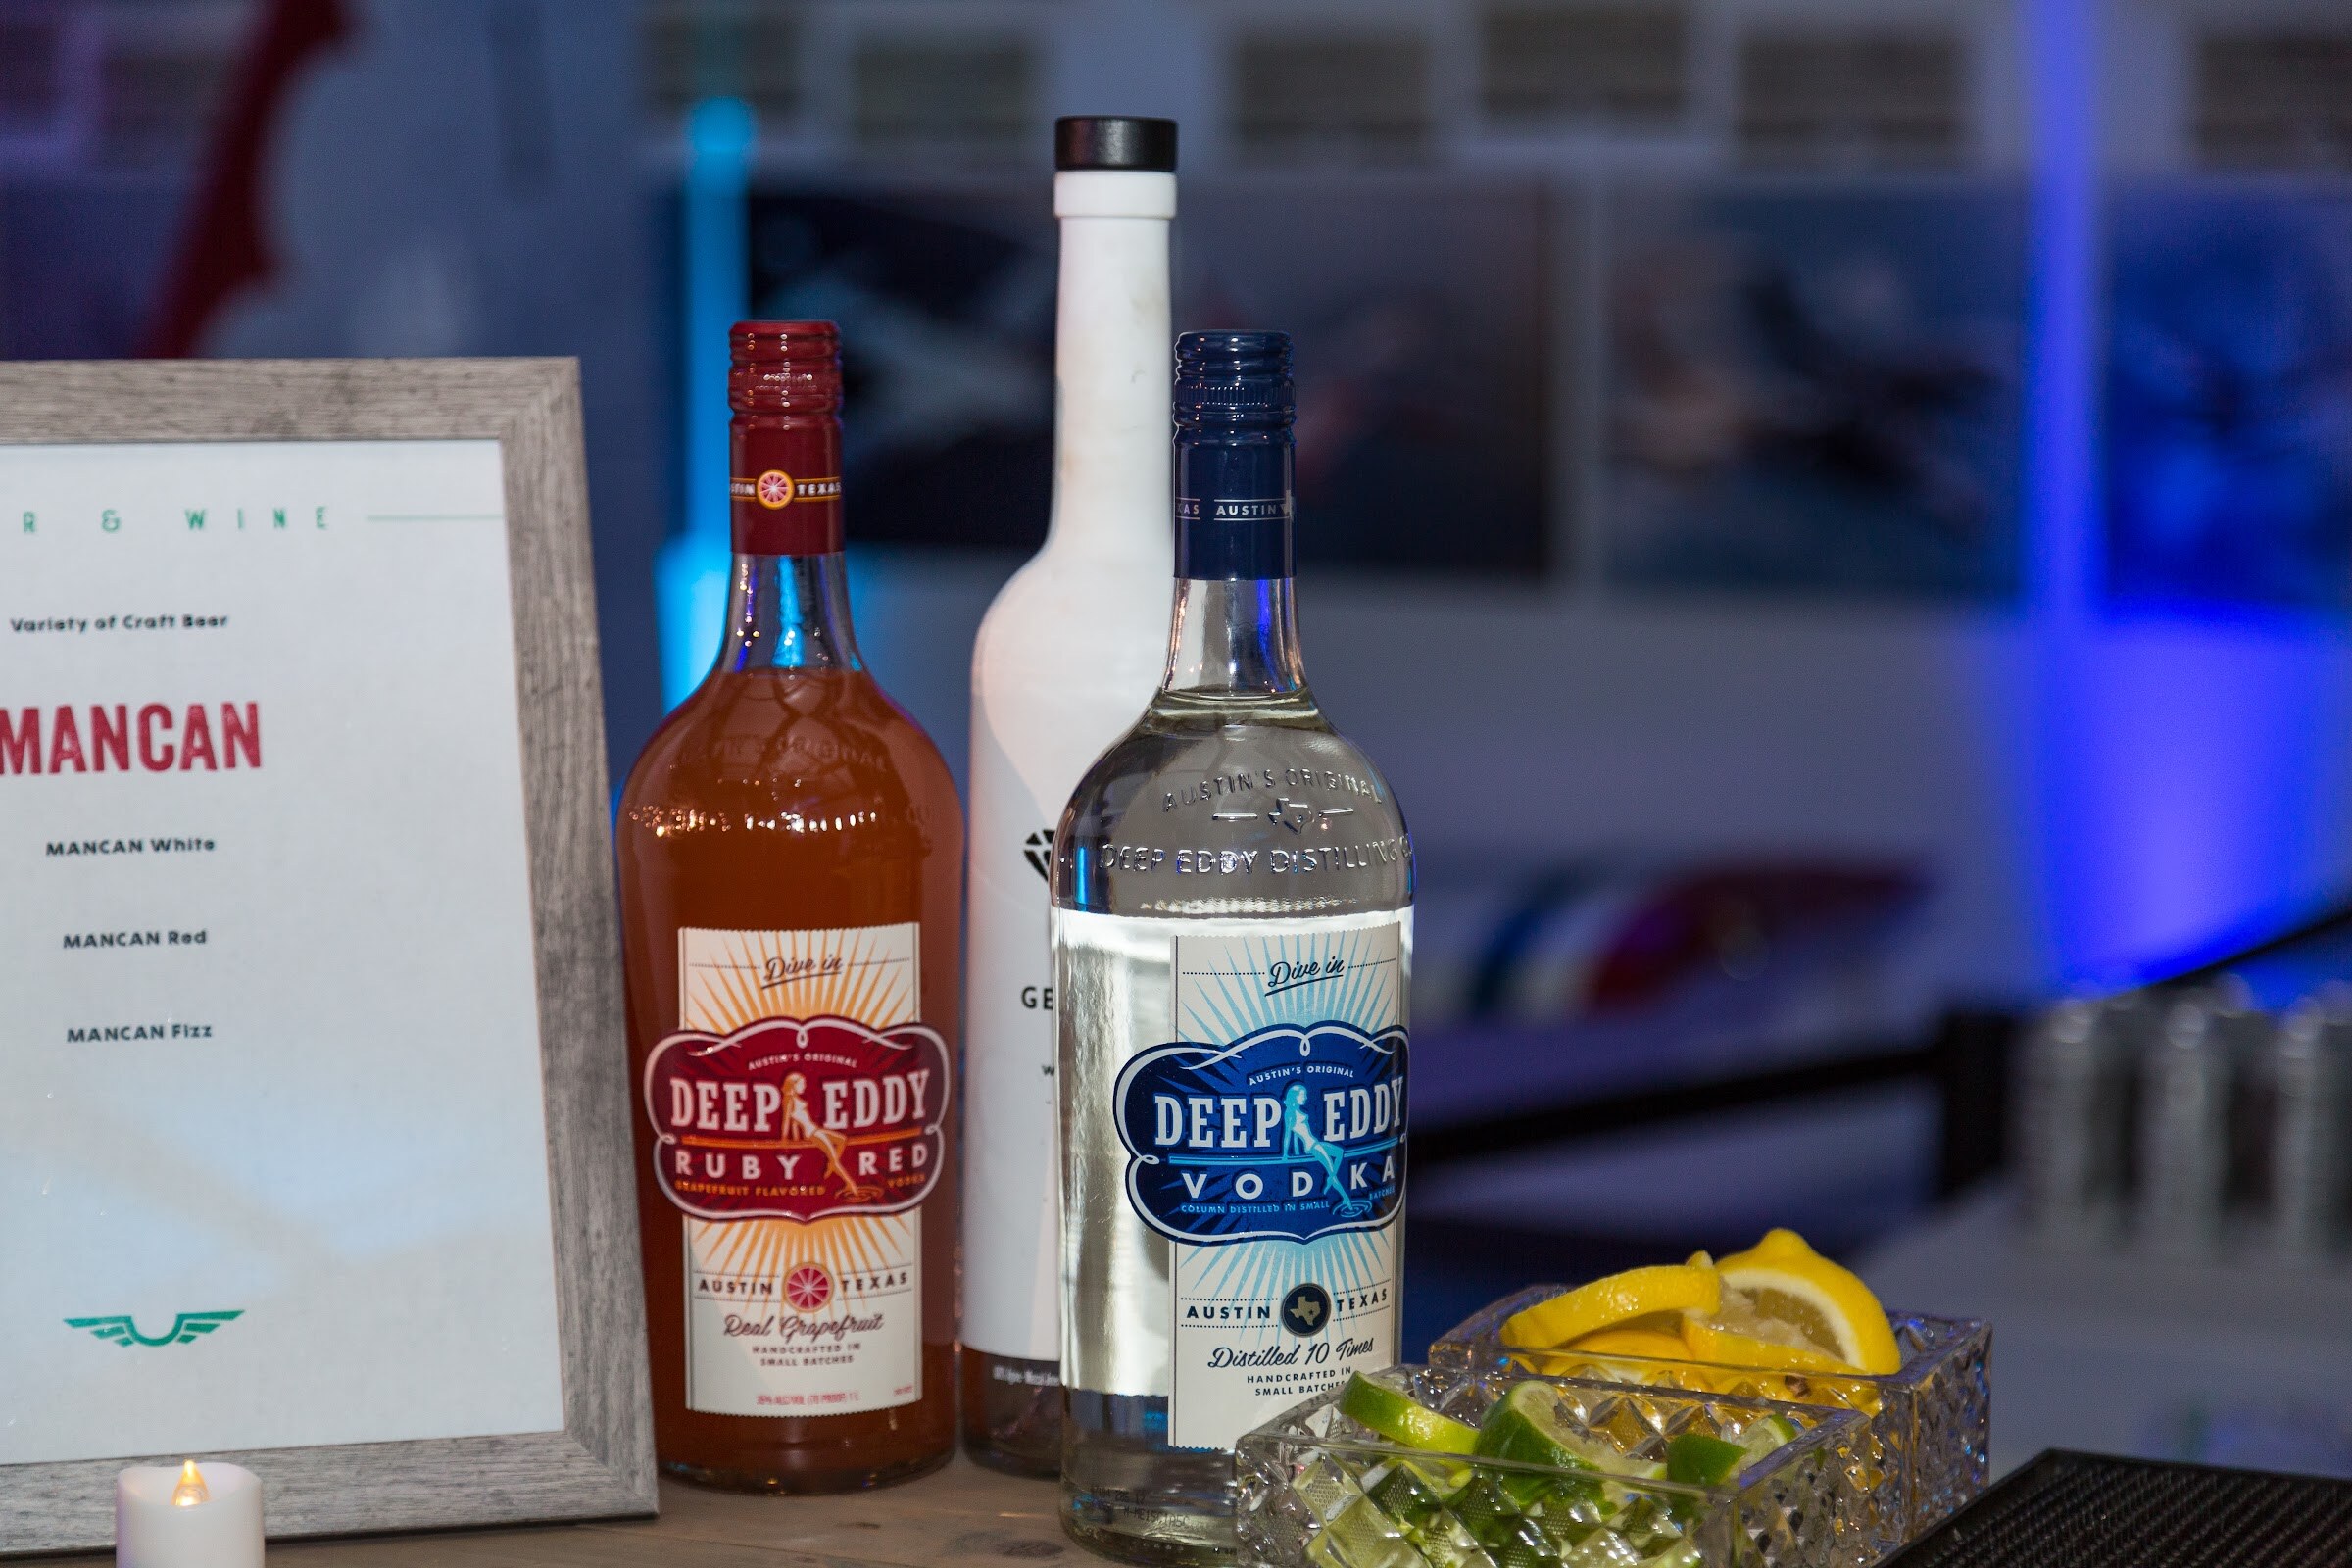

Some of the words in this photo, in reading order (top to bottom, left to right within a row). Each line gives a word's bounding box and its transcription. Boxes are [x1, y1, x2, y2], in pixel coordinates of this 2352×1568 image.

[797, 481, 842, 497] TEXAS
[100, 508, 122, 534] &
[184, 505, 328, 532] WINE
[1215, 505, 1277, 516] AUSTIN
[10, 617, 87, 634] Variety
[95, 614, 117, 630] of
[122, 614, 175, 630] Craft
[182, 614, 228, 628] Beer
[0, 701, 262, 775] MANCAN
[1162, 768, 1277, 812] AUSTIN'S
[1284, 768, 1382, 804] ORIGINAL
[46, 839, 144, 856] MANCAN
[150, 836, 217, 853] White
[1099, 844, 1167, 873] DEEP
[1176, 848, 1259, 876] EDDY
[63, 931, 161, 949] MANCAN
[168, 928, 208, 945] Red
[763, 956, 816, 980] Dive
[821, 954, 844, 972] in
[1268, 960, 1321, 988] Dive
[1324, 956, 1345, 975] in
[67, 1024, 165, 1043] MANCAN
[172, 1022, 213, 1039] Fizz
[748, 1054, 800, 1071] AUSTIN'S
[803, 1053, 858, 1069] ORIGINAL
[1249, 1065, 1302, 1087] AUSTIN'S
[1306, 1064, 1354, 1079] ORIGINAL
[669, 1077, 782, 1133] DEEP
[821, 1069, 931, 1130] EDDY
[1154, 1094, 1283, 1149] DEEP
[1323, 1076, 1404, 1143] EDDY
[674, 1150, 803, 1181] RUBY
[858, 1142, 929, 1177] RED
[1181, 1155, 1396, 1200] VODKA
[755, 1186, 826, 1197] FLAVORED
[1181, 1203, 1225, 1215] COLUMN
[1229, 1203, 1281, 1215] DISTILLED
[1284, 1202, 1297, 1213] IN
[1299, 1200, 1331, 1212] SMALL
[698, 1278, 773, 1296] AUSTIN
[841, 1272, 908, 1293] TEXAS
[1186, 1305, 1271, 1320] AUSTIN
[1336, 1287, 1389, 1313] TEXAS
[723, 1314, 775, 1338] Real
[778, 1313, 885, 1344] Grapefruit
[752, 1343, 842, 1355] HANDCRAFTED
[847, 1342, 861, 1351] IN
[1207, 1345, 1299, 1368] Distilled
[1303, 1341, 1330, 1365] 10
[1335, 1337, 1375, 1361] Times
[760, 1357, 798, 1367] SMALL
[802, 1354, 856, 1367] BATCHES
[1247, 1369, 1337, 1384] HANDCRAFTED
[1341, 1366, 1352, 1376] IN
[1254, 1386, 1294, 1396] SMALL
